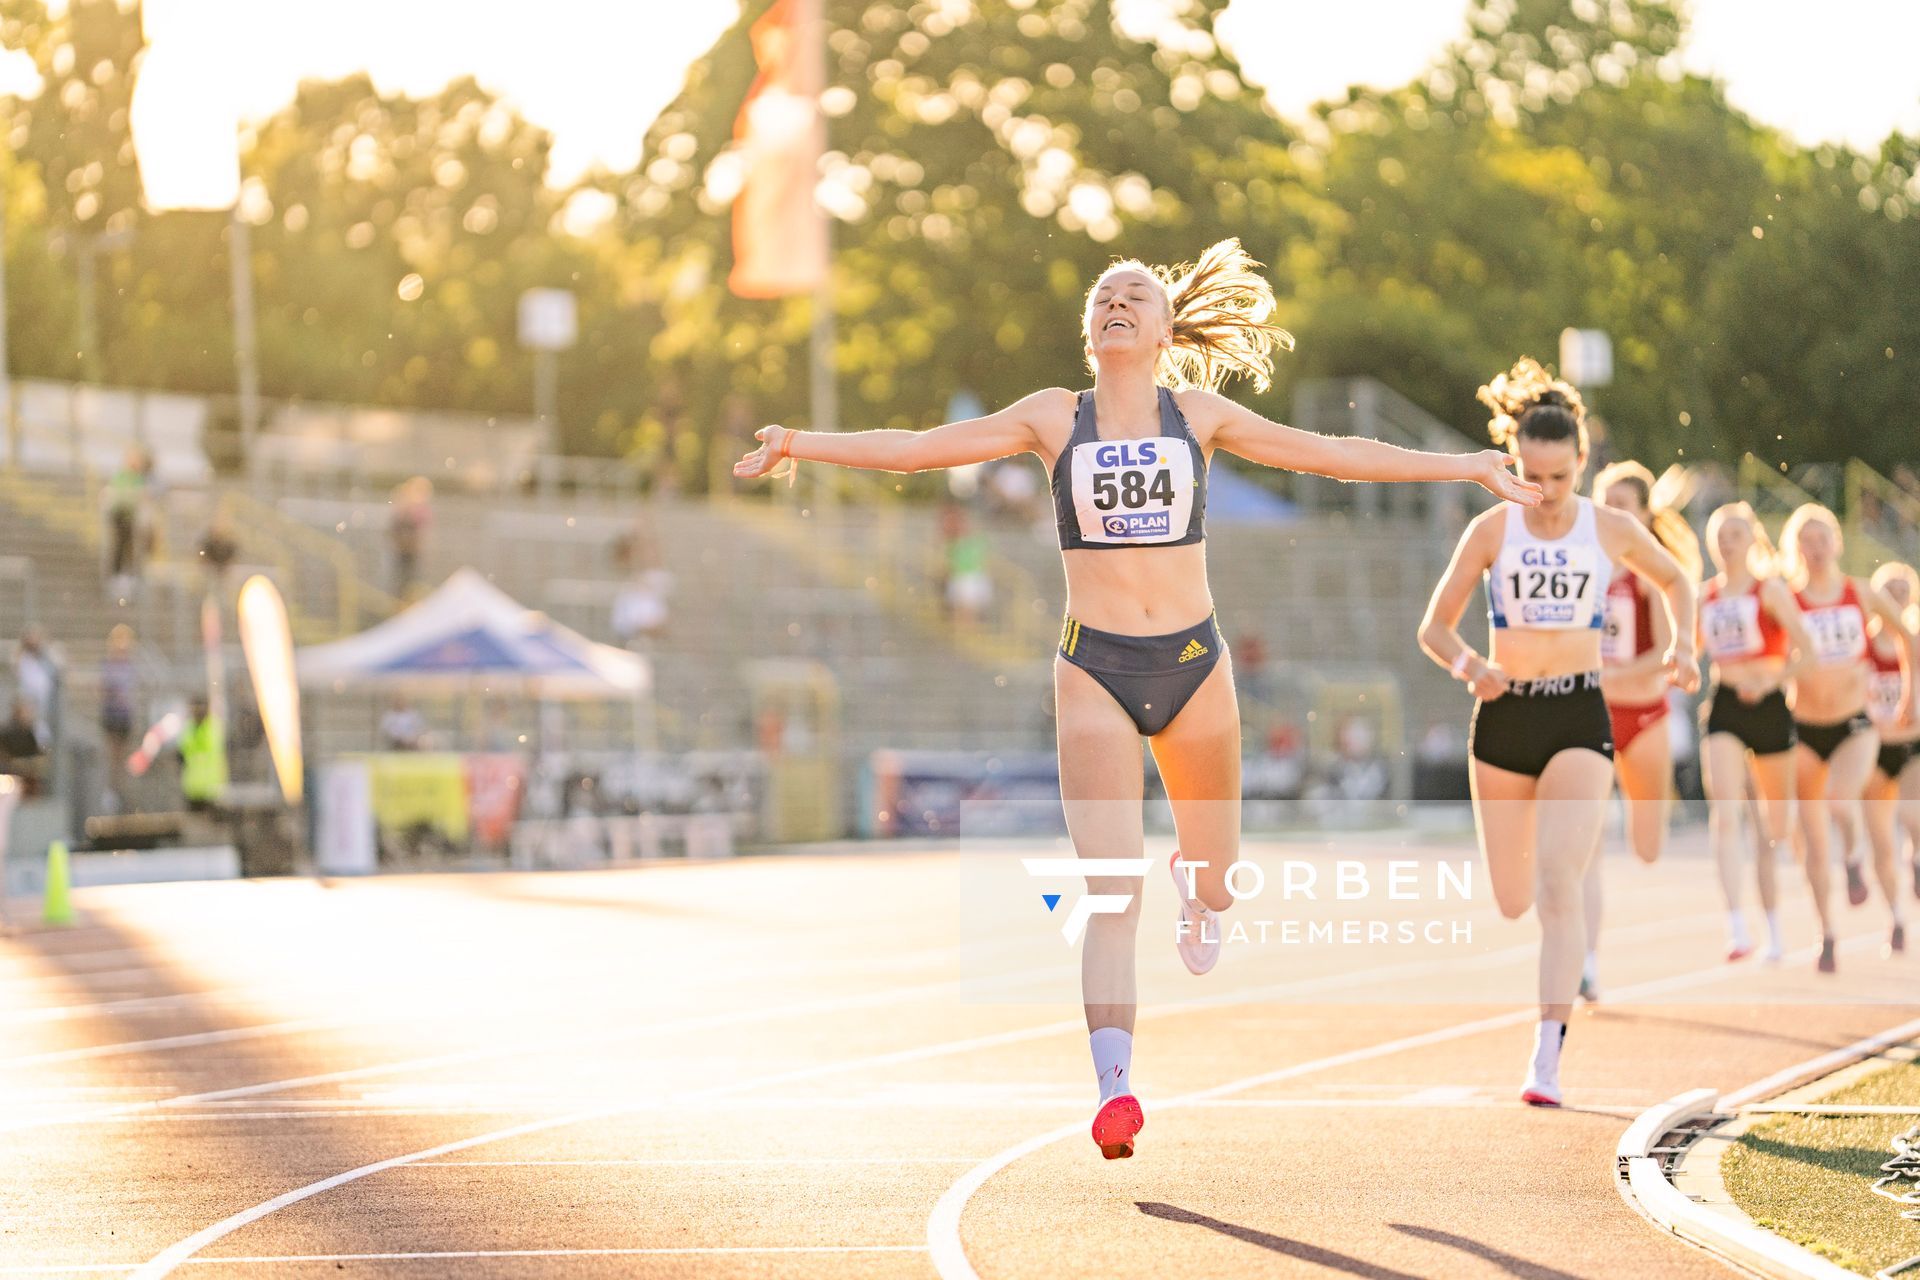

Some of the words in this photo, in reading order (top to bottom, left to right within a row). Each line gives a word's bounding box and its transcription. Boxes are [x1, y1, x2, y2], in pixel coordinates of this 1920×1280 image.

[1093, 469, 1175, 510] 584
[1130, 516, 1167, 528] PLAN
[1507, 571, 1590, 600] 1267
[1178, 646, 1209, 664] adidas
[1528, 672, 1576, 698] PRO
